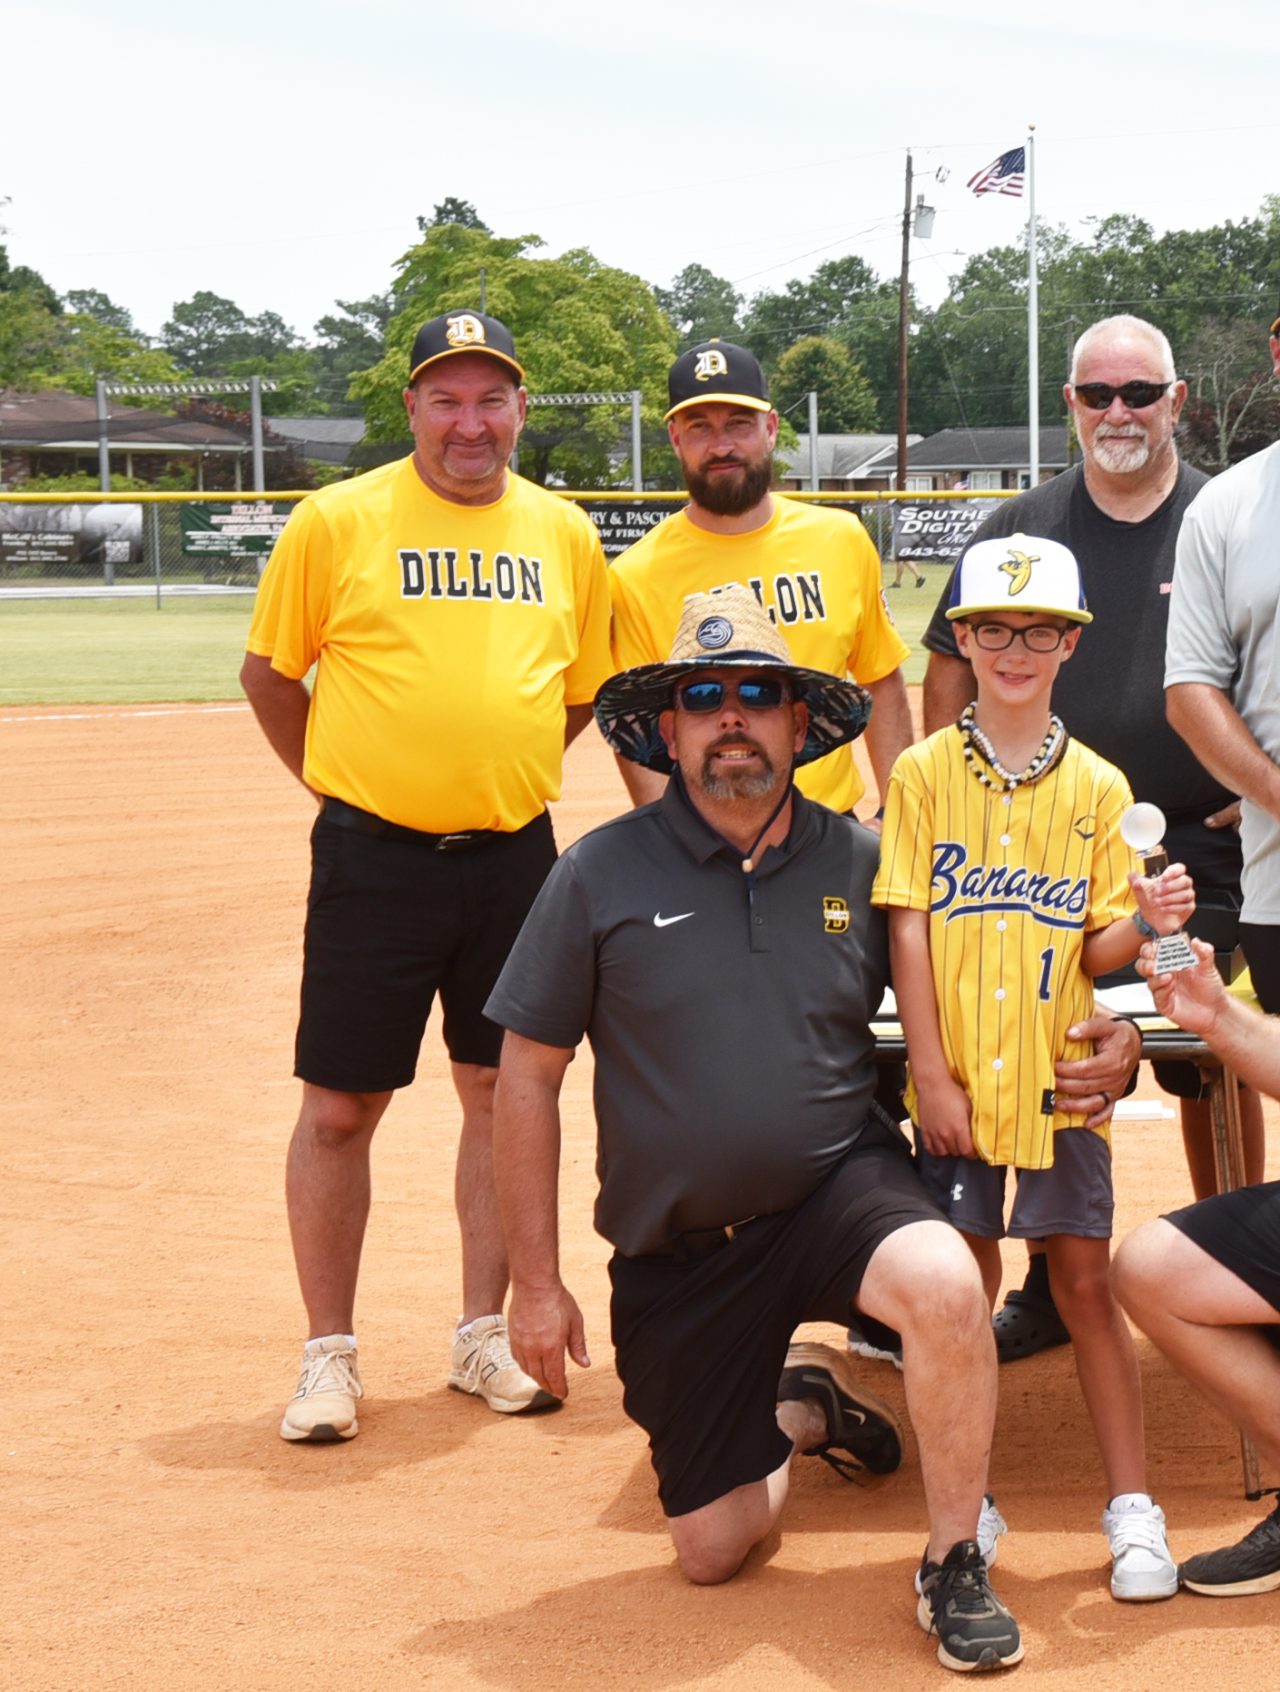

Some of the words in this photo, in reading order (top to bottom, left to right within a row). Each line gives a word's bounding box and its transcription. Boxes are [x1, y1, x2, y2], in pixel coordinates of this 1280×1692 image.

[610, 511, 623, 525] &
[397, 549, 545, 606] DILLON
[930, 841, 1088, 914] Bananas
[1038, 946, 1055, 1003] 1
